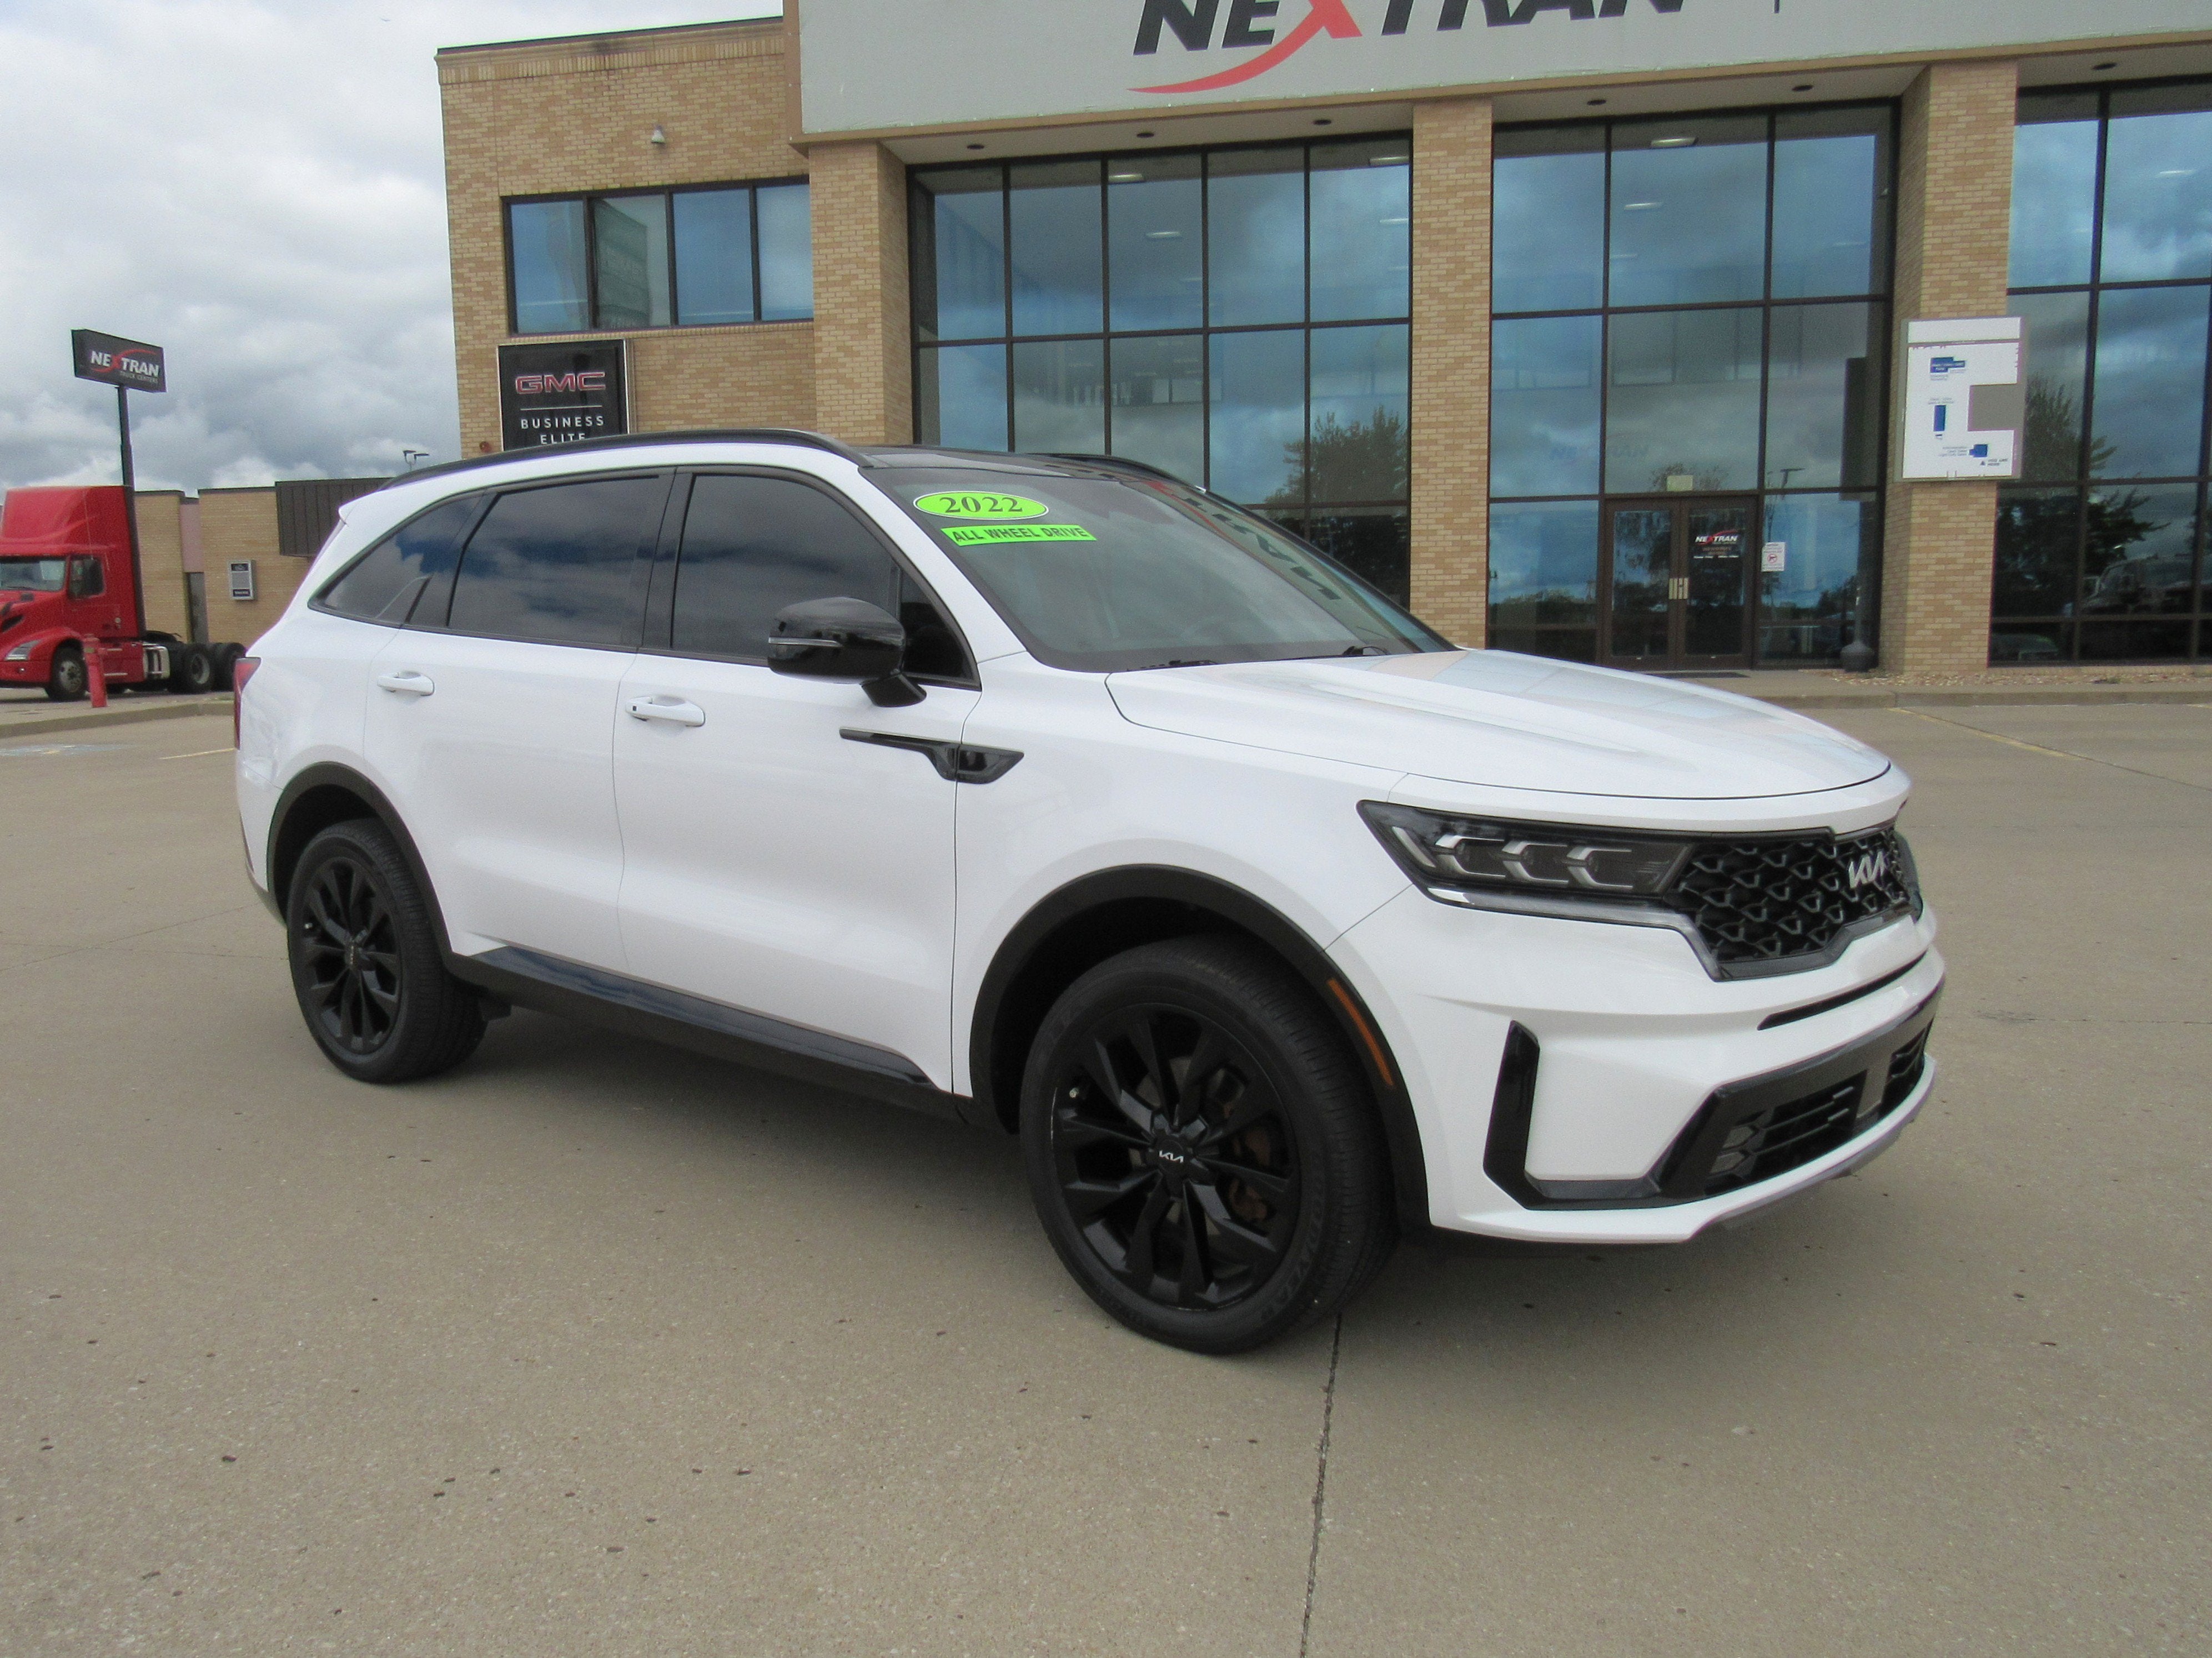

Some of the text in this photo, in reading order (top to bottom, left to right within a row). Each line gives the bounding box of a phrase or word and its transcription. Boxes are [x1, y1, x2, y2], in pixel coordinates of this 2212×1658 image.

[90, 350, 159, 377] NEXTRAN
[515, 371, 606, 395] GMC
[520, 415, 604, 430] BUSINESS
[939, 496, 1023, 513] 2022
[952, 527, 1087, 542] ALL WHEEL DRIVE
